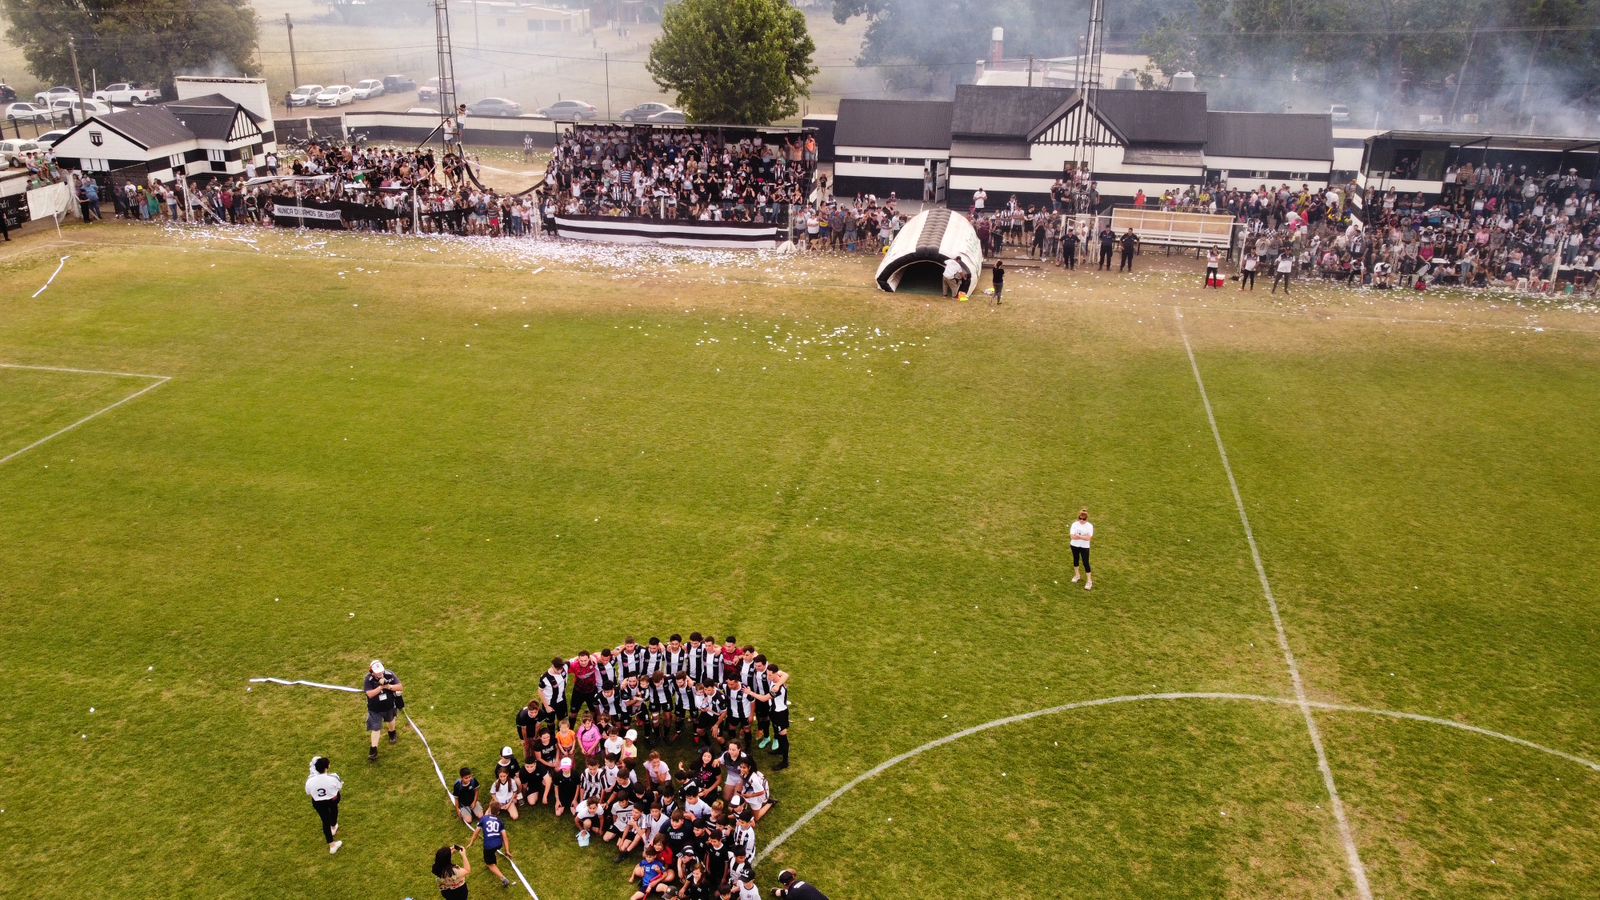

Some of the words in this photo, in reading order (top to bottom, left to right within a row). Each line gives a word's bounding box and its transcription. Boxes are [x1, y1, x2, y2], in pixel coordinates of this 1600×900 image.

[317, 210, 324, 218] DE
[317, 788, 327, 797] 3
[486, 820, 500, 832] 30
